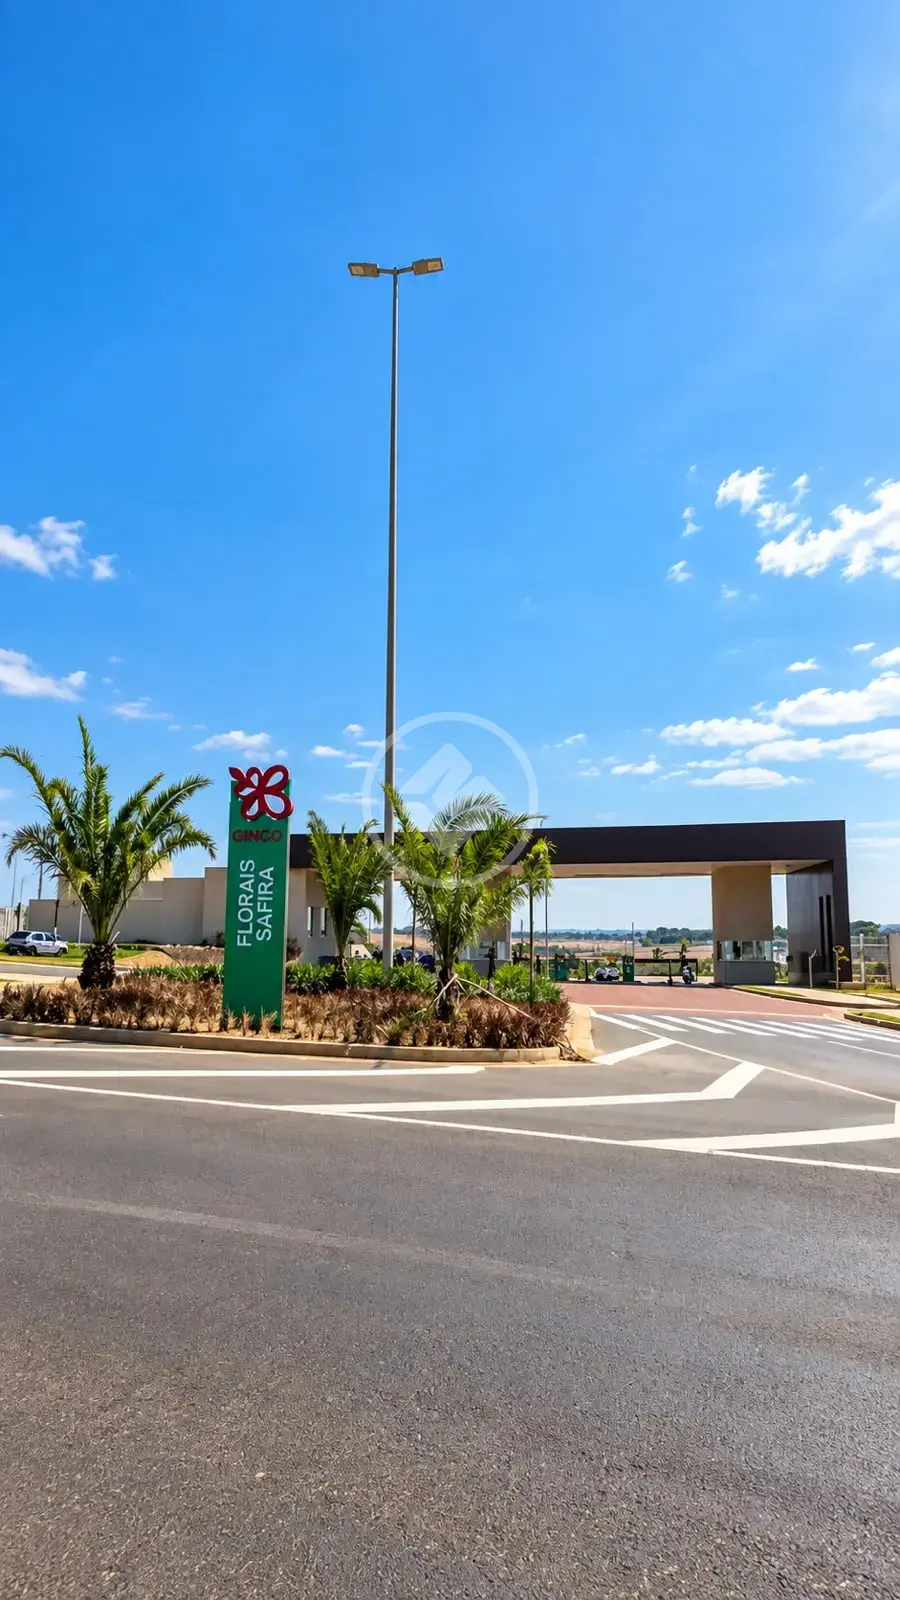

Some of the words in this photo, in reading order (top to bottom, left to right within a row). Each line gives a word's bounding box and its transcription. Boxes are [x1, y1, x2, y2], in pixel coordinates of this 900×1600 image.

[232, 829, 283, 842] GINCO
[237, 859, 255, 947] FLORAIS
[256, 866, 274, 941] SAFIRA
